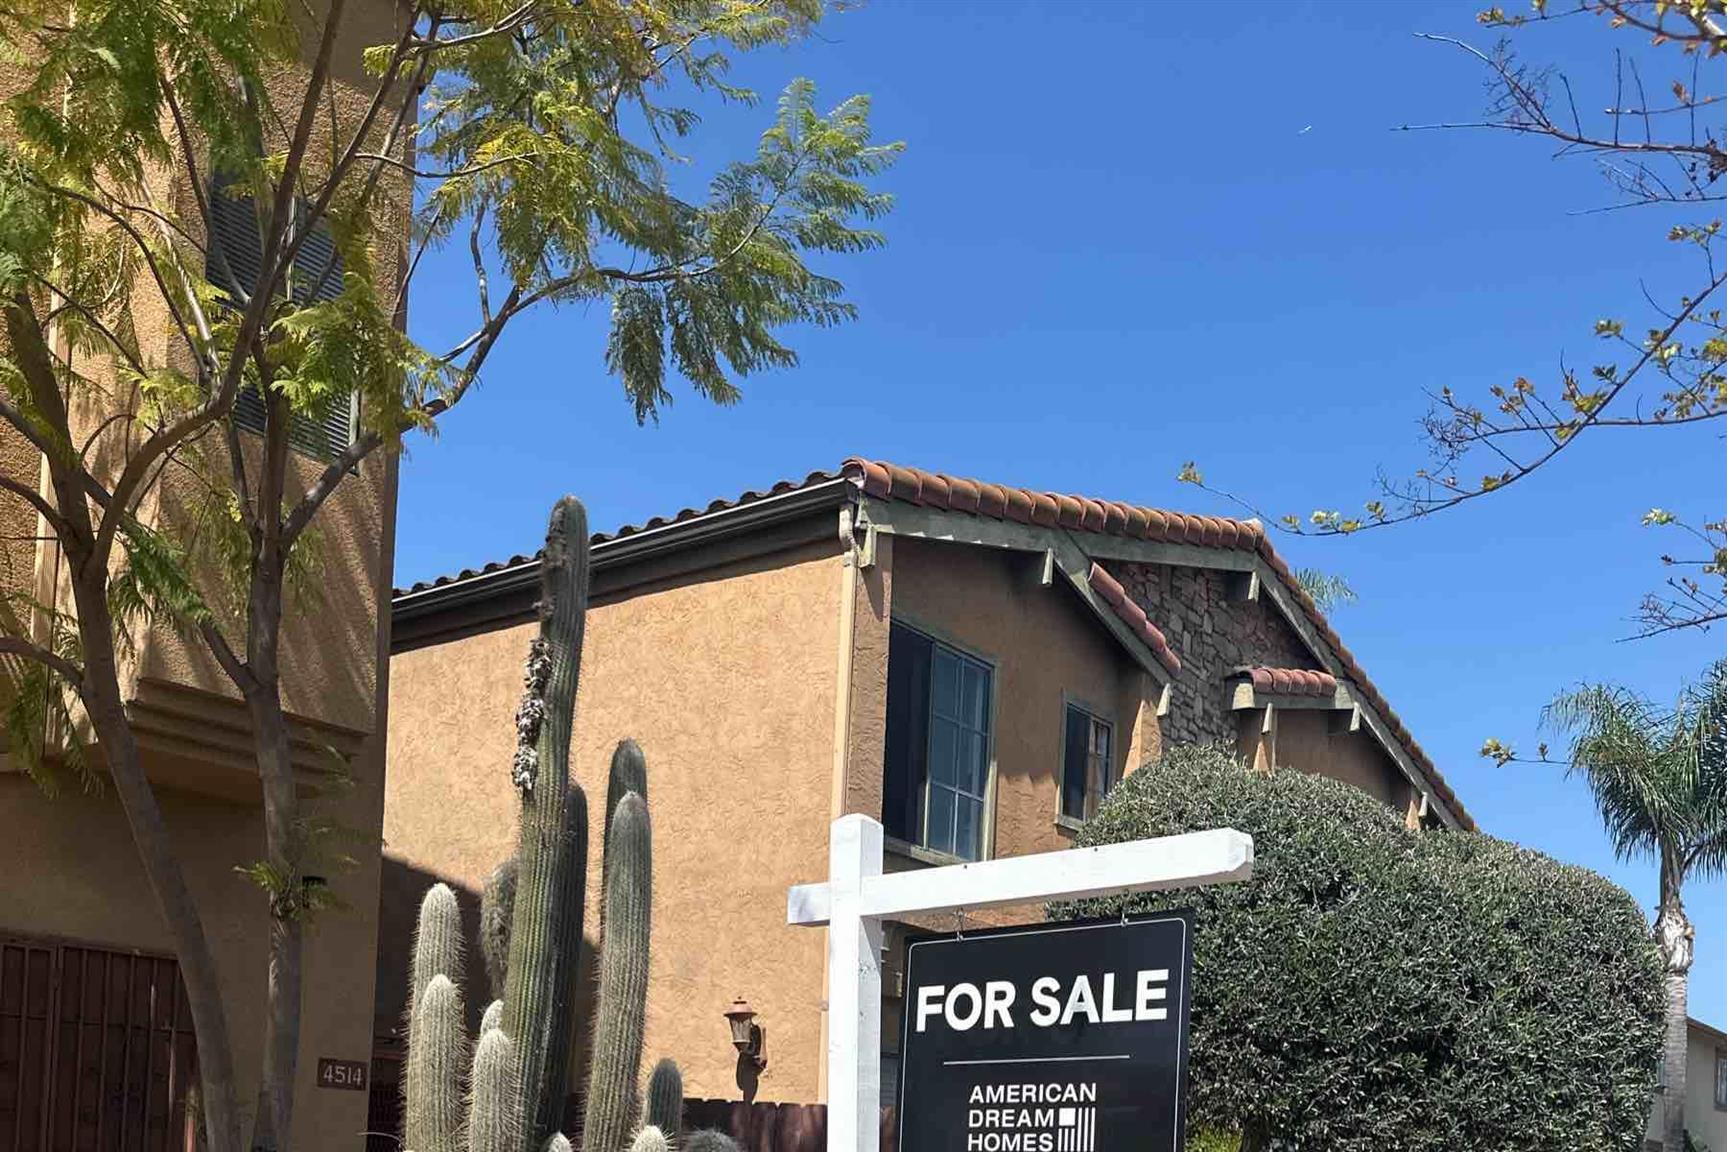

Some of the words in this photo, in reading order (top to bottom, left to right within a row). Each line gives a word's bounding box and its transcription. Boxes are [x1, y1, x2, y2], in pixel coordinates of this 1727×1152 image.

[915, 980, 1016, 1033] FOR
[1029, 968, 1169, 1027] SALE
[323, 1065, 362, 1085] 4514
[969, 1082, 1097, 1104] AMERICAN
[968, 1108, 1055, 1128] DREAM
[967, 1132, 1054, 1152] HOMES
